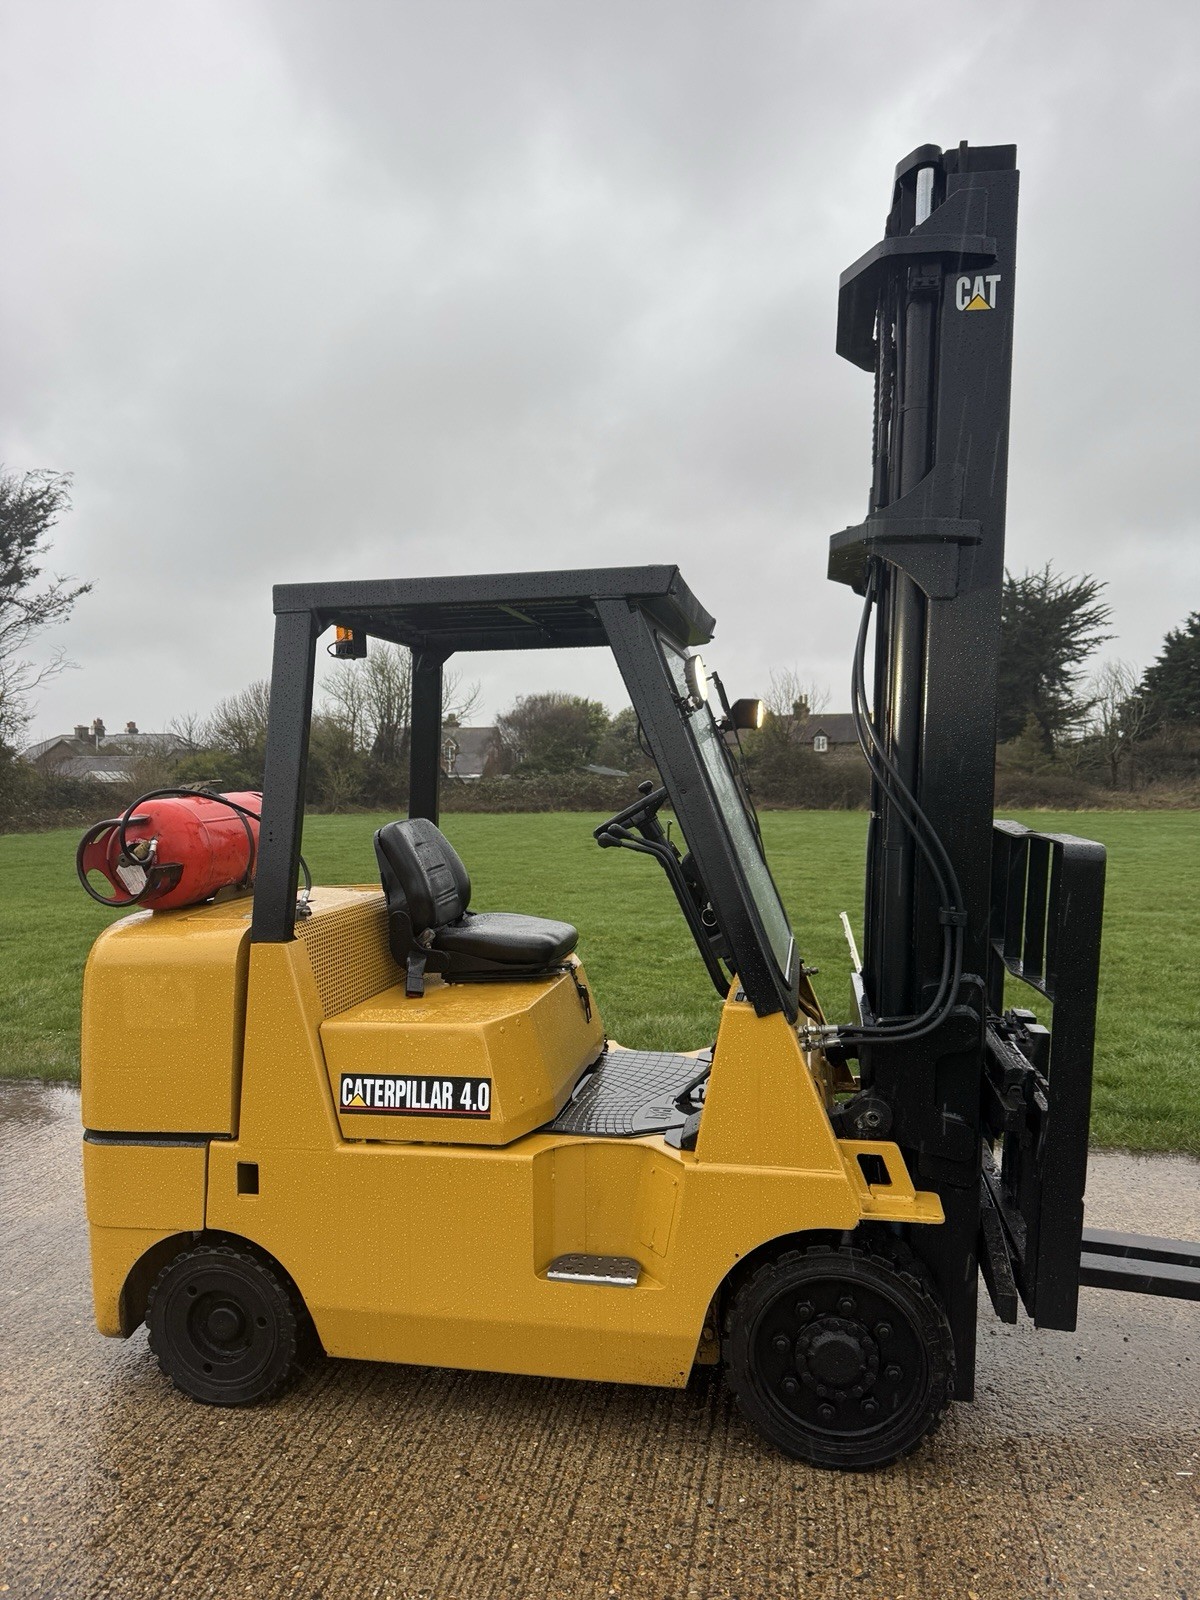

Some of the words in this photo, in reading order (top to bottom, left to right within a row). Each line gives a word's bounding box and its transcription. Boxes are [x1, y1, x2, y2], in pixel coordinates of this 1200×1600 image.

[956, 275, 1001, 311] CAT
[342, 1078, 453, 1109] CATERPILLAR
[460, 1082, 490, 1111] 4.0
